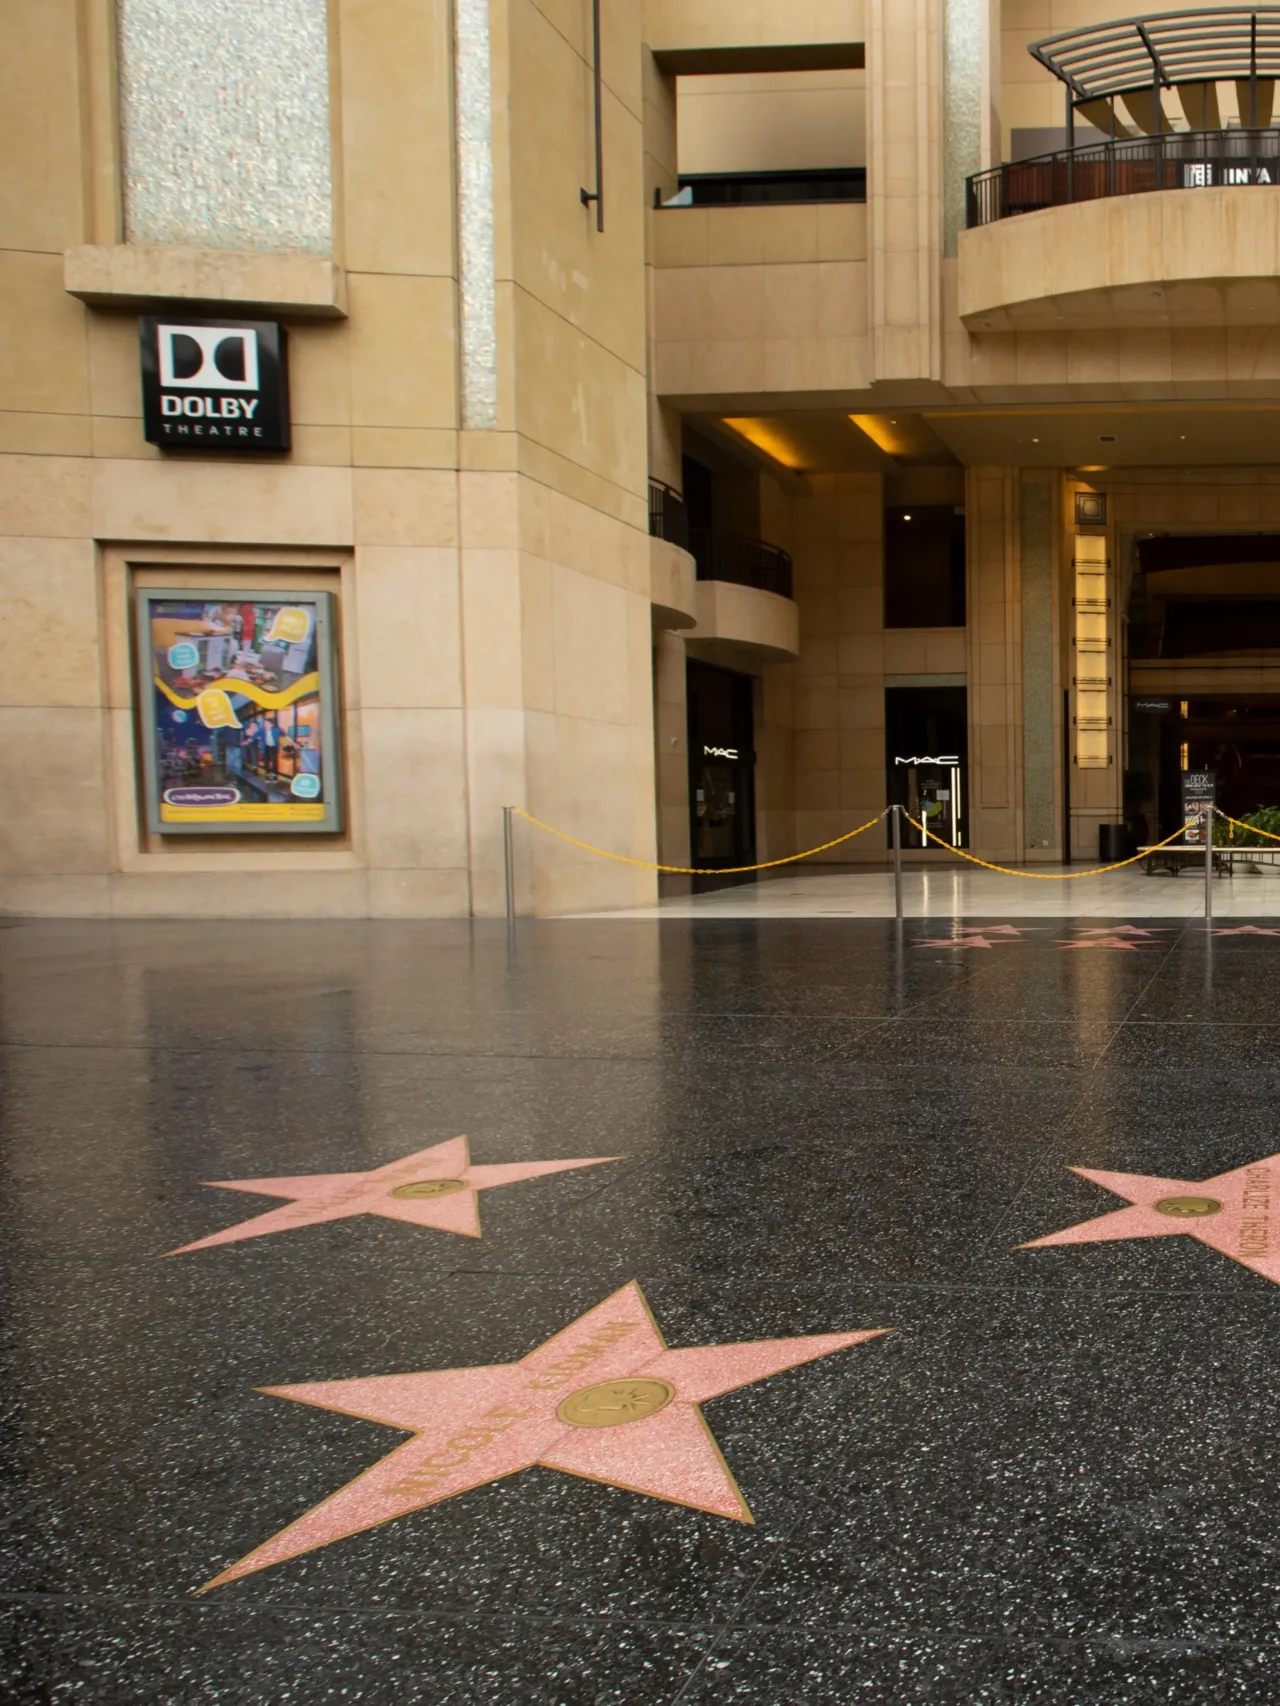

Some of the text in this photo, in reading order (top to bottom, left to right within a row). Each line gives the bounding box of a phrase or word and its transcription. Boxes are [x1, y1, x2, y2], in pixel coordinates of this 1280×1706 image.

[160, 394, 260, 419] DOLBY
[162, 423, 263, 437] THEATRE
[1238, 1167, 1271, 1258] CHARLIZE THERON
[384, 1321, 641, 1496] NICOLE KIDMAN
